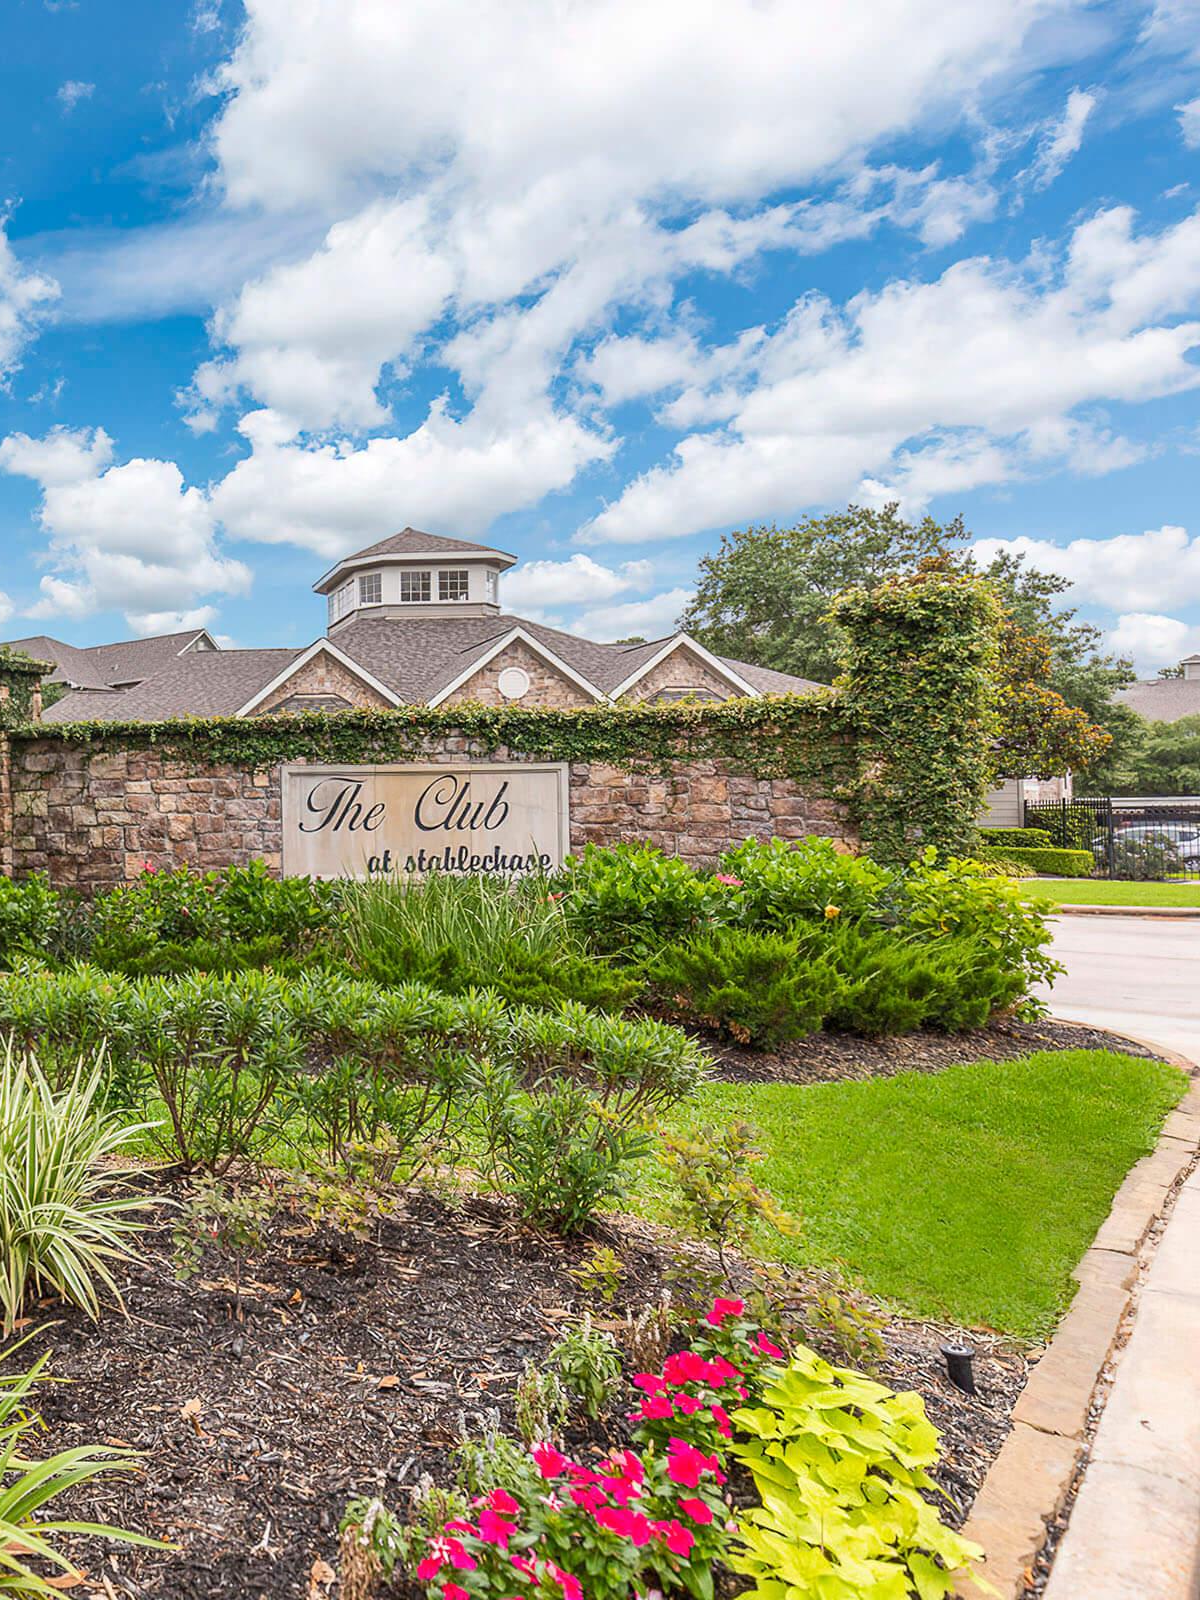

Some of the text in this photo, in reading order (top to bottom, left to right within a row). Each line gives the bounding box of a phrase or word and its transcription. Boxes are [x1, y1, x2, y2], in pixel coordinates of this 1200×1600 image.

[298, 774, 510, 832] The Club
[368, 846, 553, 873] at stablechase
